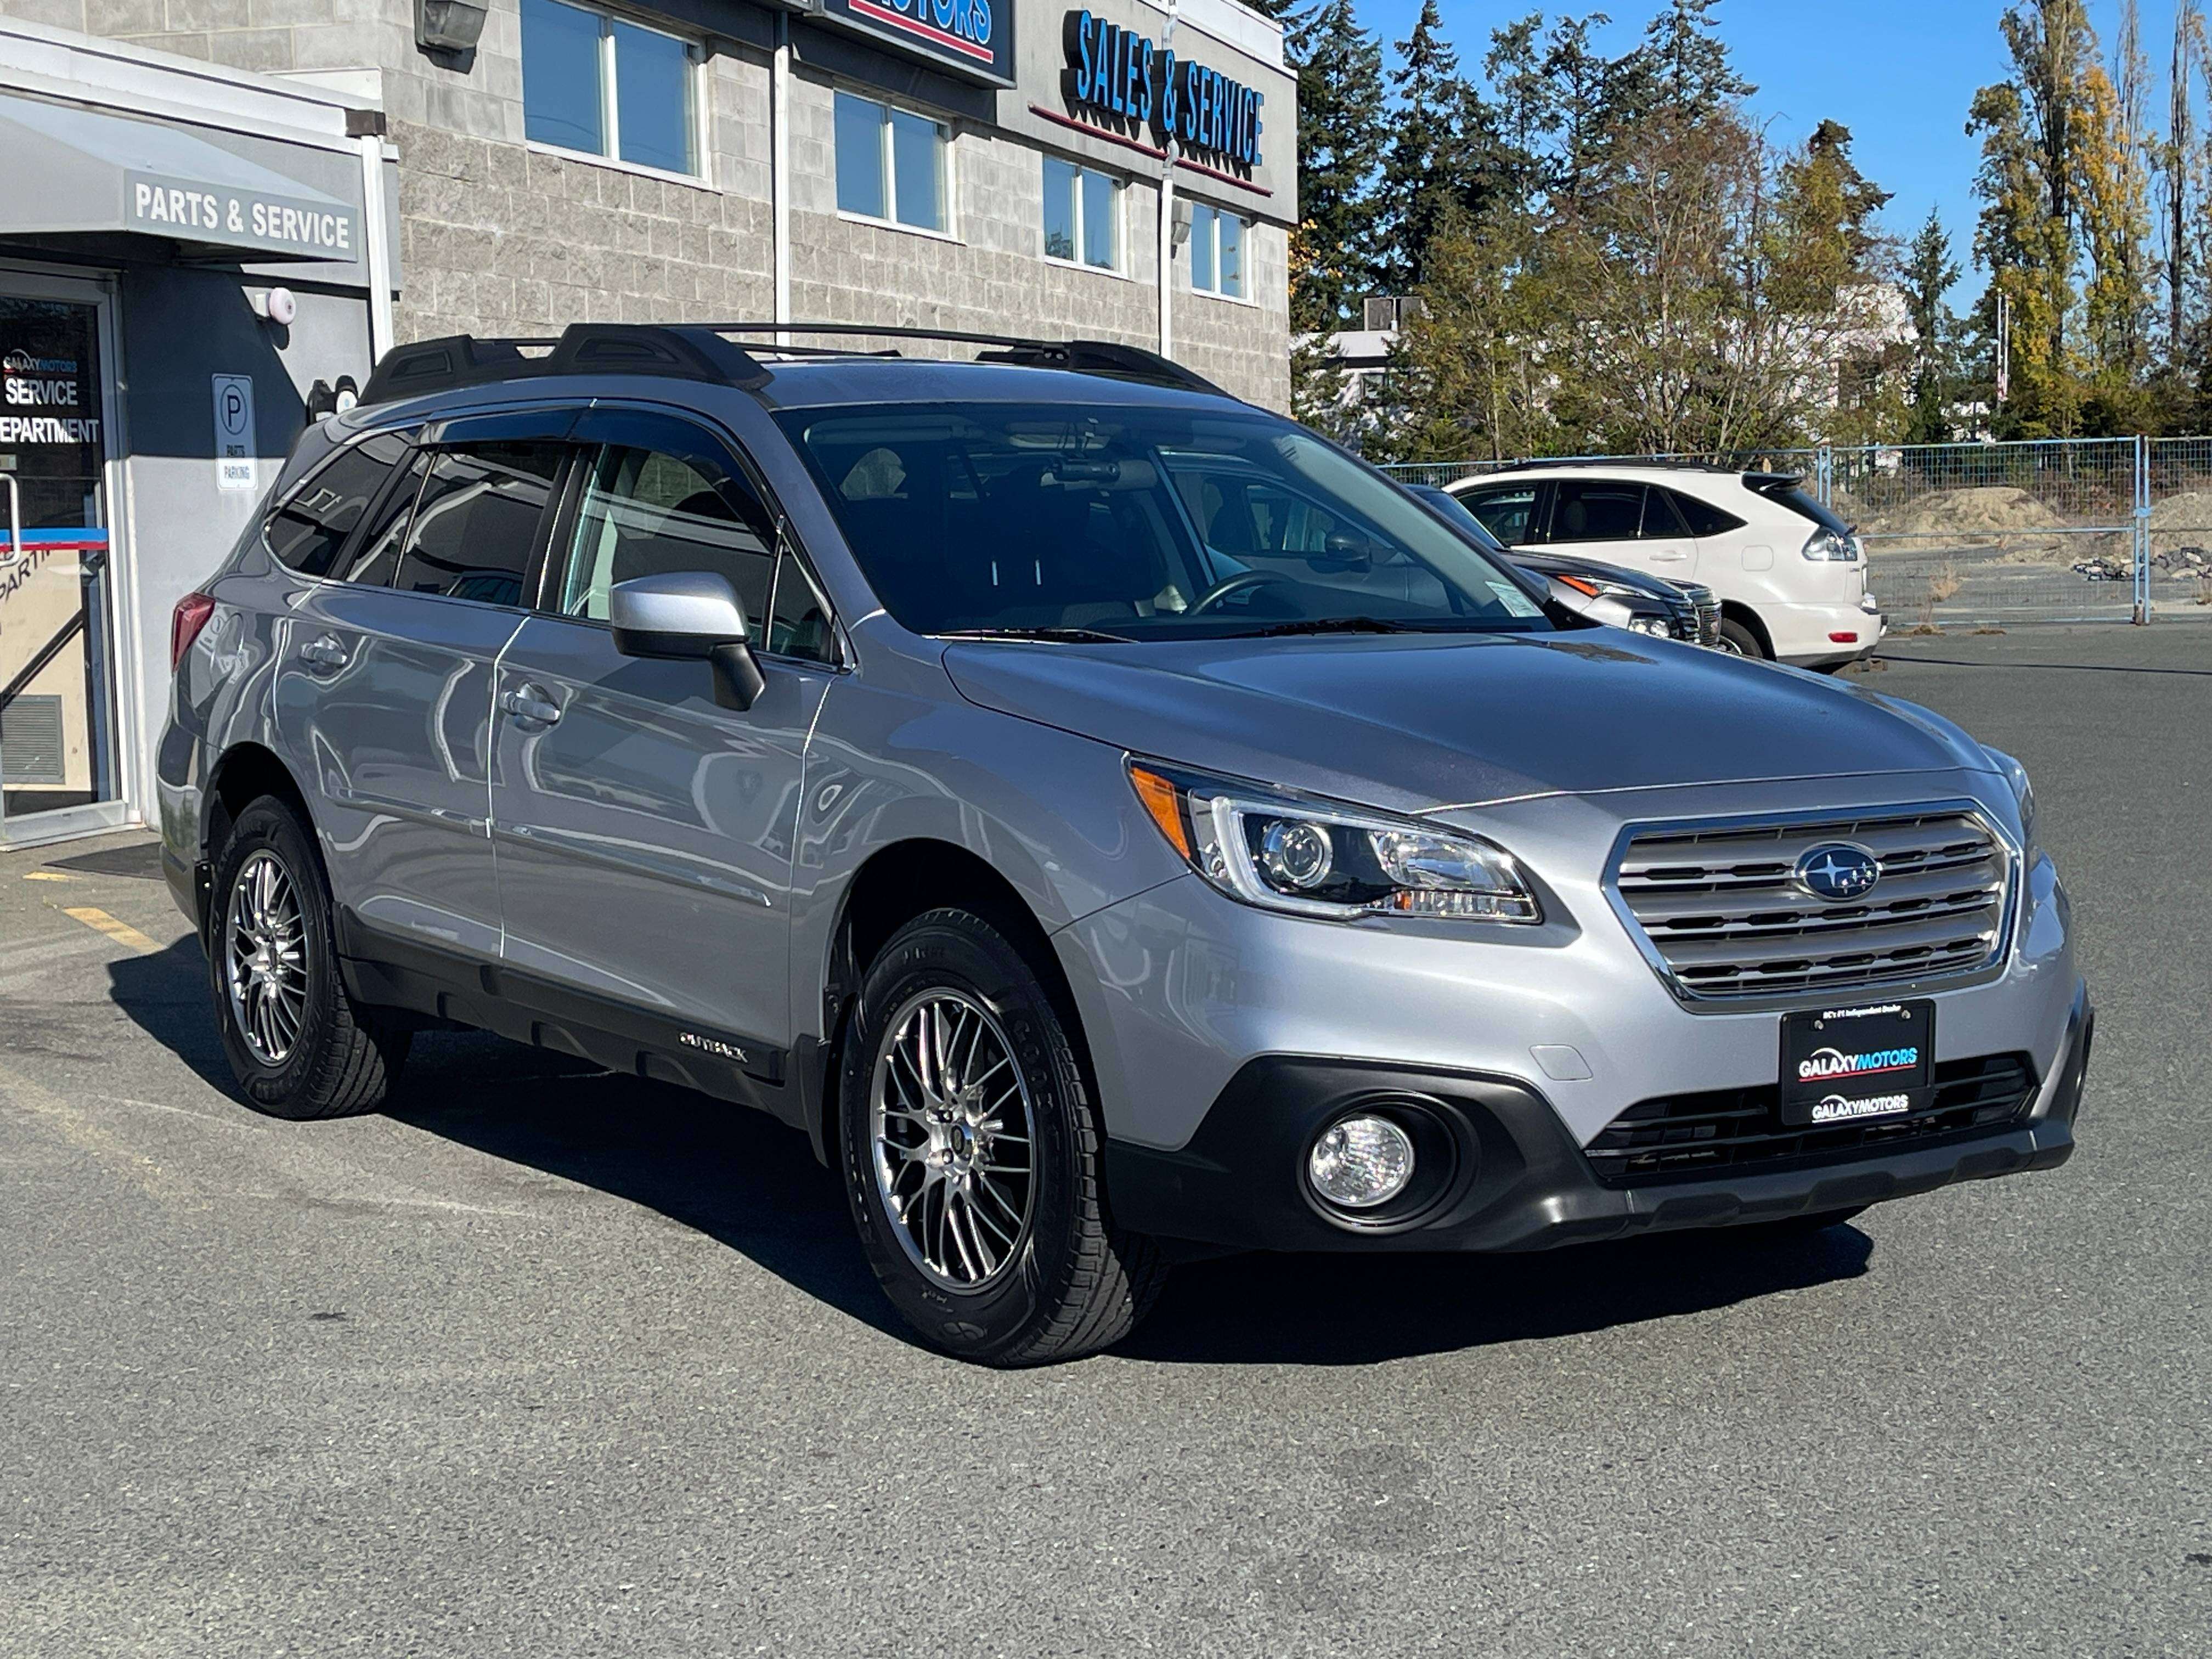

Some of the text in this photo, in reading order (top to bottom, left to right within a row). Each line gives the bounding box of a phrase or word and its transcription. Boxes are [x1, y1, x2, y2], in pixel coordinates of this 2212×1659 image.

[1075, 9, 1264, 166] SALES & SERVICE
[135, 183, 349, 249] PARTS & SERVICE
[5, 377, 78, 405] SERVICE
[227, 394, 240, 427] P
[0, 416, 99, 443] EPARTMENT
[227, 444, 245, 458] PARTS
